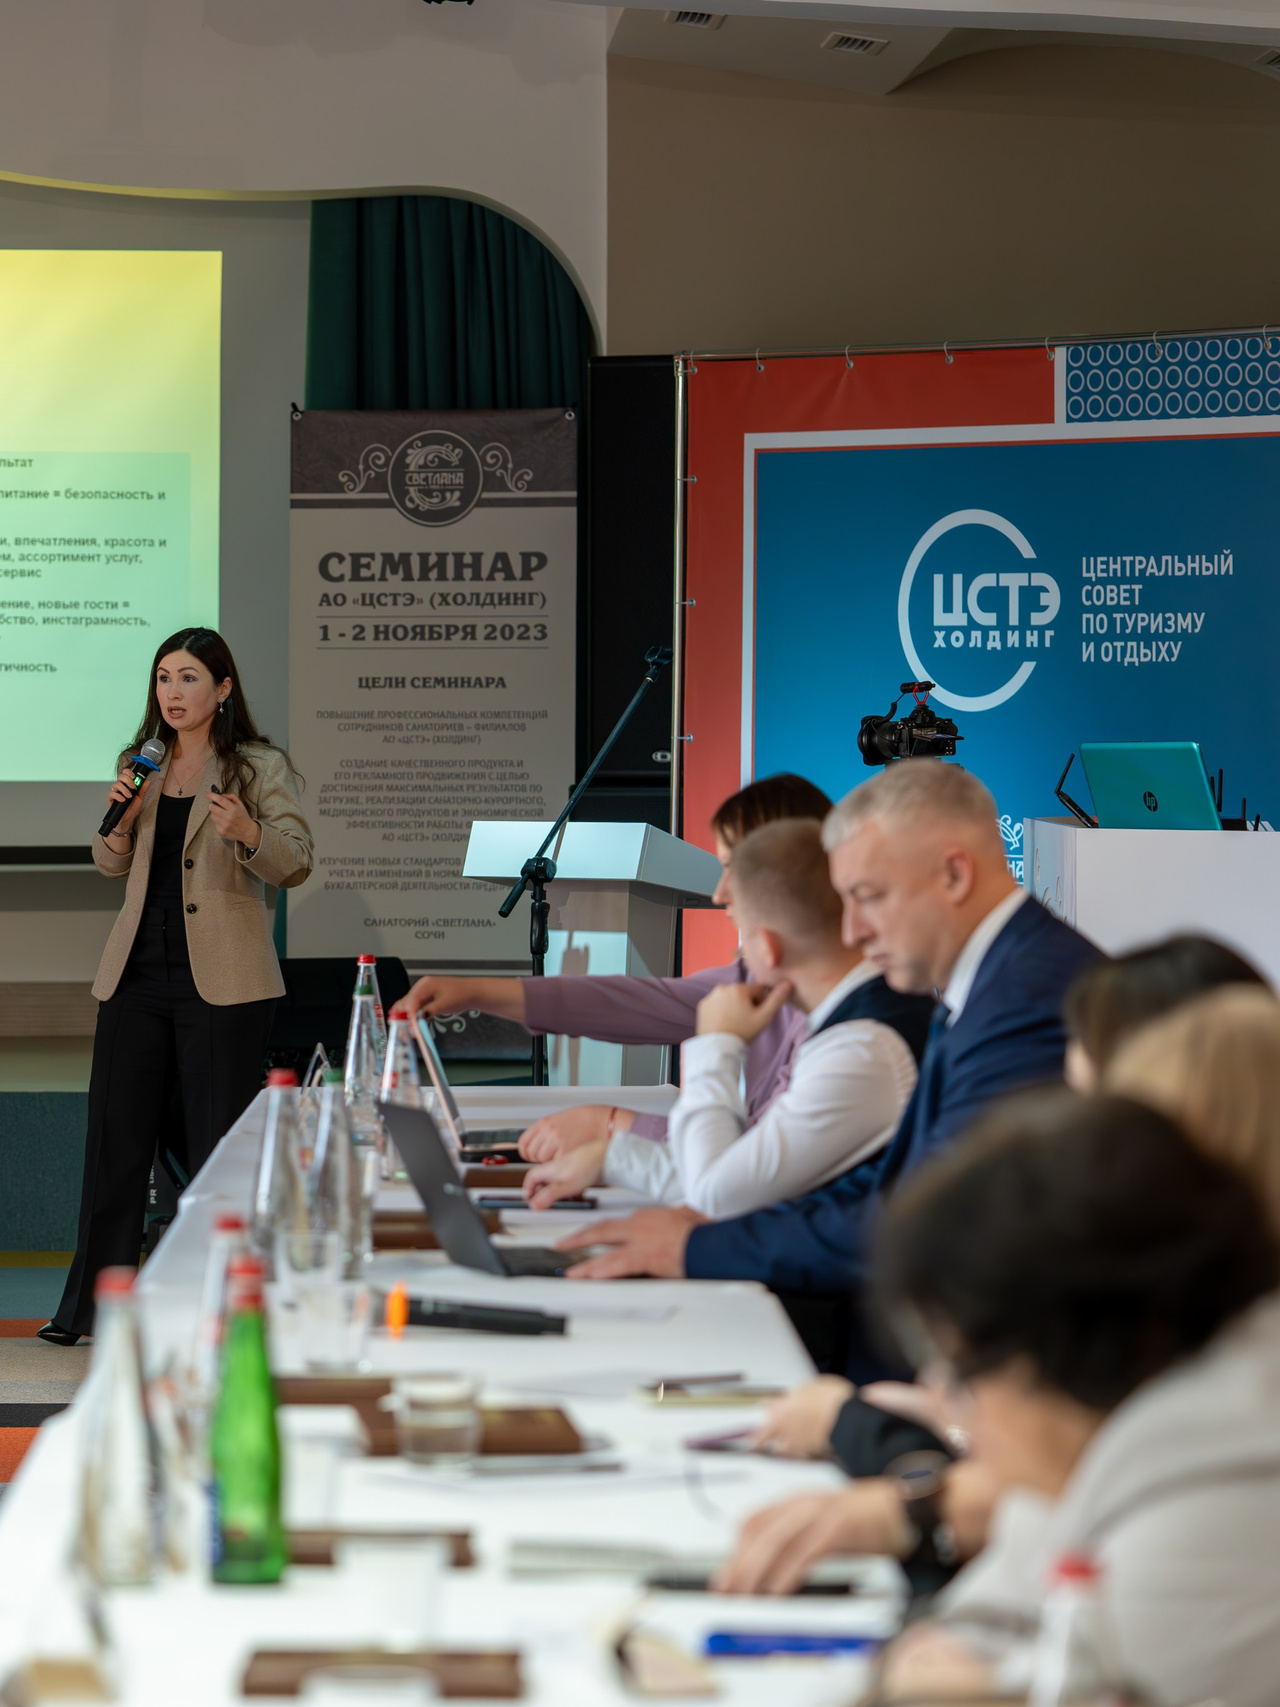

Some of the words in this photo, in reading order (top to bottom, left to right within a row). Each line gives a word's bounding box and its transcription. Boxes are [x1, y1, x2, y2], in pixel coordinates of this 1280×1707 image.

[405, 472, 464, 485] СВЕТЛАНА
[64, 488, 153, 500] безопасность
[157, 492, 166, 500] и
[14, 537, 100, 547] впечатления,
[104, 538, 155, 549] красота
[158, 539, 167, 547] и
[18, 553, 101, 564] ассортимент
[105, 554, 142, 565] услуг,
[1081, 549, 1234, 581] ЦЕНТРАЛЬНЫЙ
[318, 551, 548, 583] СЕМИНАР
[320, 593, 347, 606] АО
[352, 592, 424, 609] «ЦСТЭ»
[429, 592, 548, 609] (ХОЛДИНГ)
[933, 573, 1061, 626] ЦСТЭ
[1081, 584, 1142, 606] СОВЕТ
[37, 601, 80, 609] новые
[83, 601, 119, 610] гости
[42, 616, 150, 627] инстаграмность,
[1082, 613, 1108, 634] ПО
[1113, 612, 1205, 634] ТУРИЗМУ
[319, 625, 330, 641] 1
[353, 624, 365, 641] 2
[373, 624, 477, 641] НОЯБРЯ
[484, 624, 547, 641] 2023
[1082, 641, 1095, 663] И
[1101, 641, 1182, 666] ОТДЫХУ
[358, 677, 406, 690] ЦЕЛИ
[411, 677, 506, 688] СЕМИНАРА
[364, 917, 429, 927] САНАТОРИЙ
[432, 918, 496, 927] «СВЕТЛАНА»
[414, 931, 445, 939] СОЧИ
[149, 1189, 157, 1204] PR
